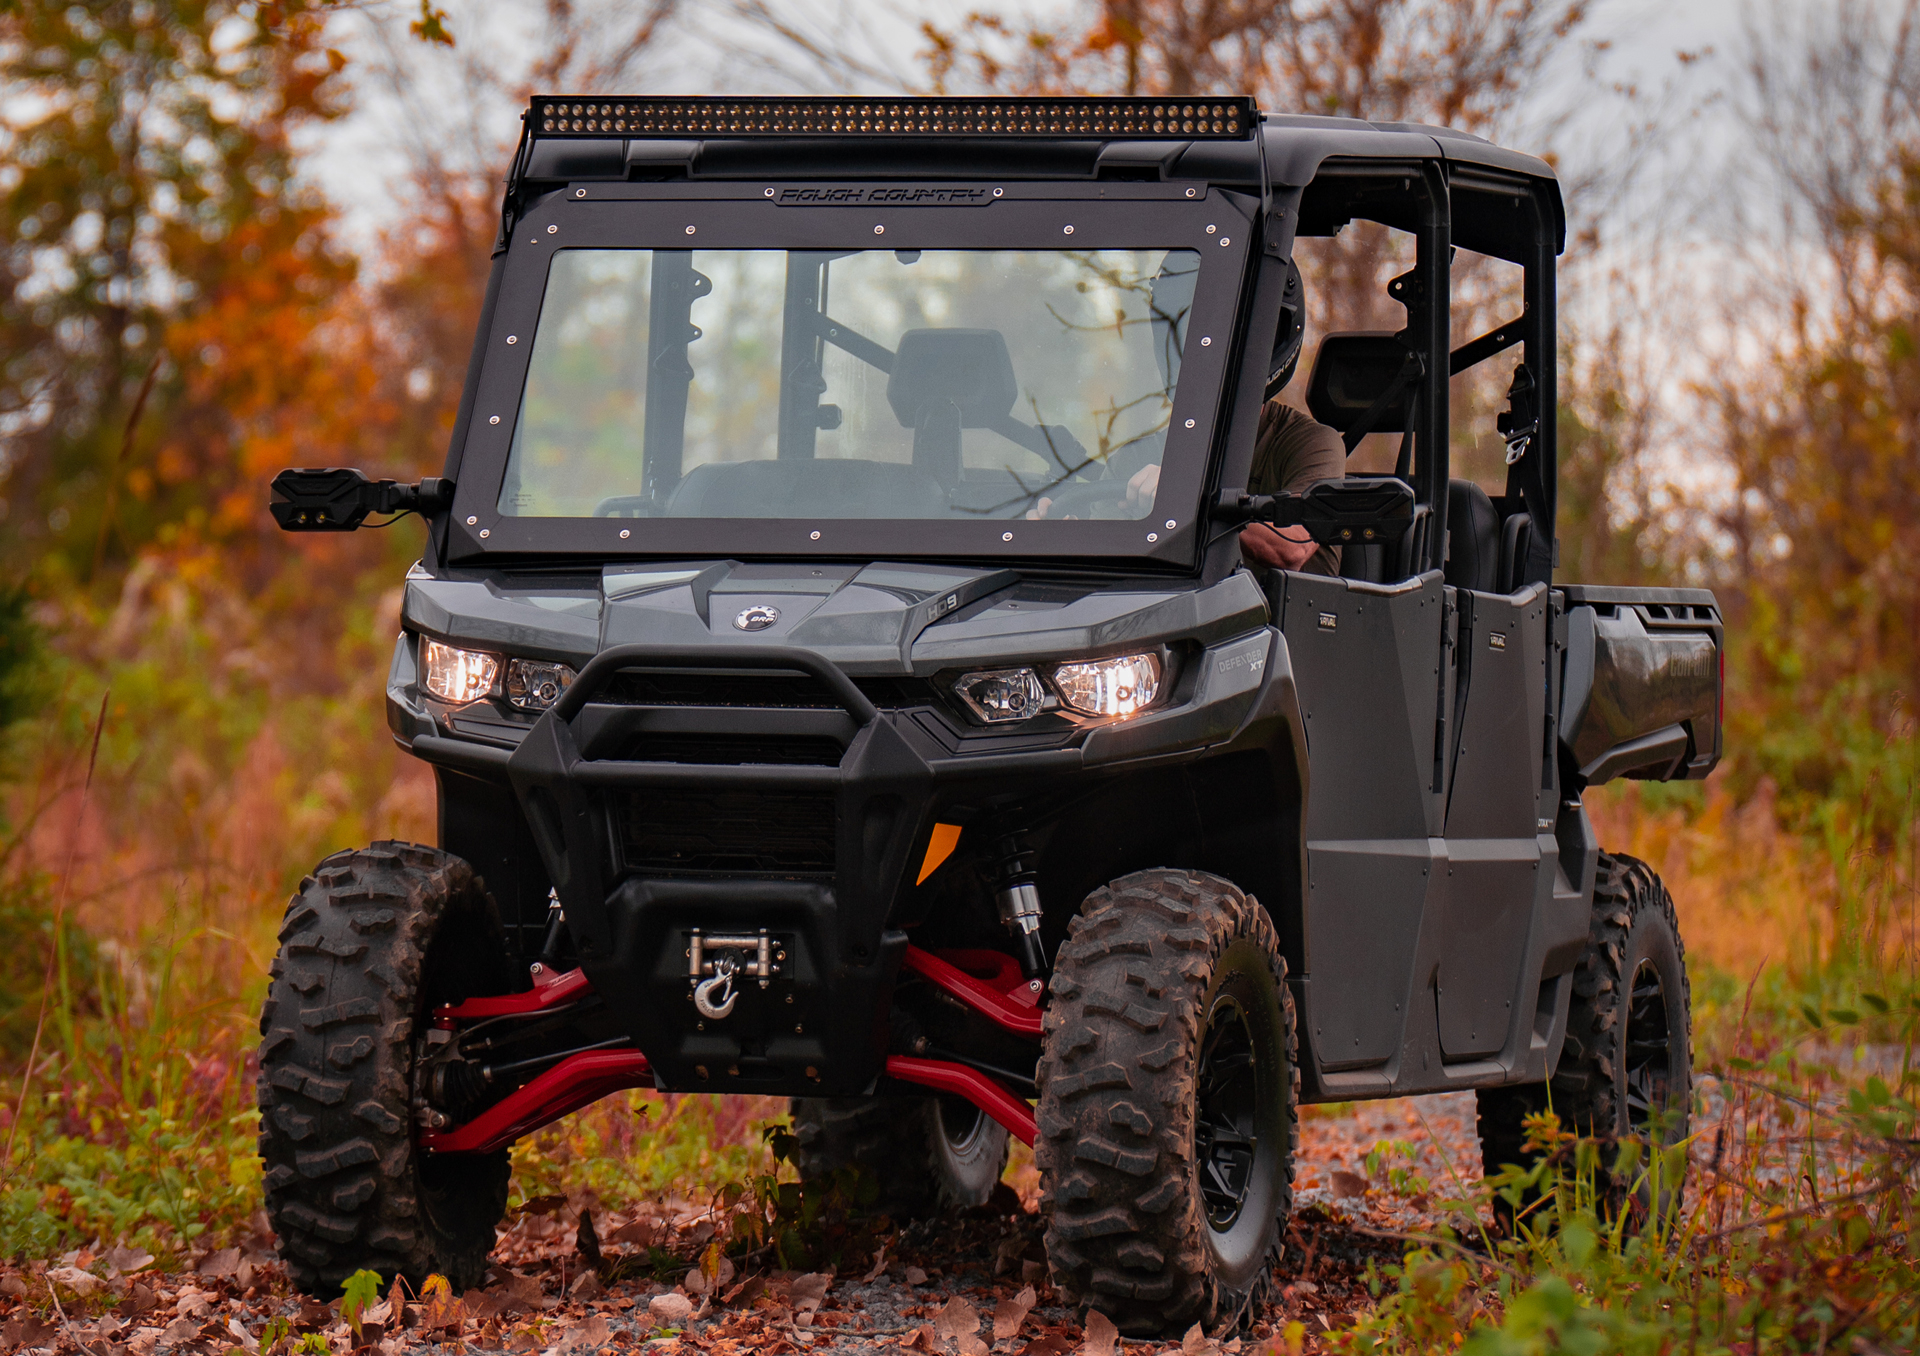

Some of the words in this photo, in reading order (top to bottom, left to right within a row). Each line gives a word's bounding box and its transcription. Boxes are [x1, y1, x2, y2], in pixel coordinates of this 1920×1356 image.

[779, 188, 864, 202] ROUGH
[867, 188, 986, 202] COUNTRY
[926, 593, 958, 620] HD9
[1218, 649, 1263, 673] DEFENDER
[1249, 660, 1264, 672] XT
